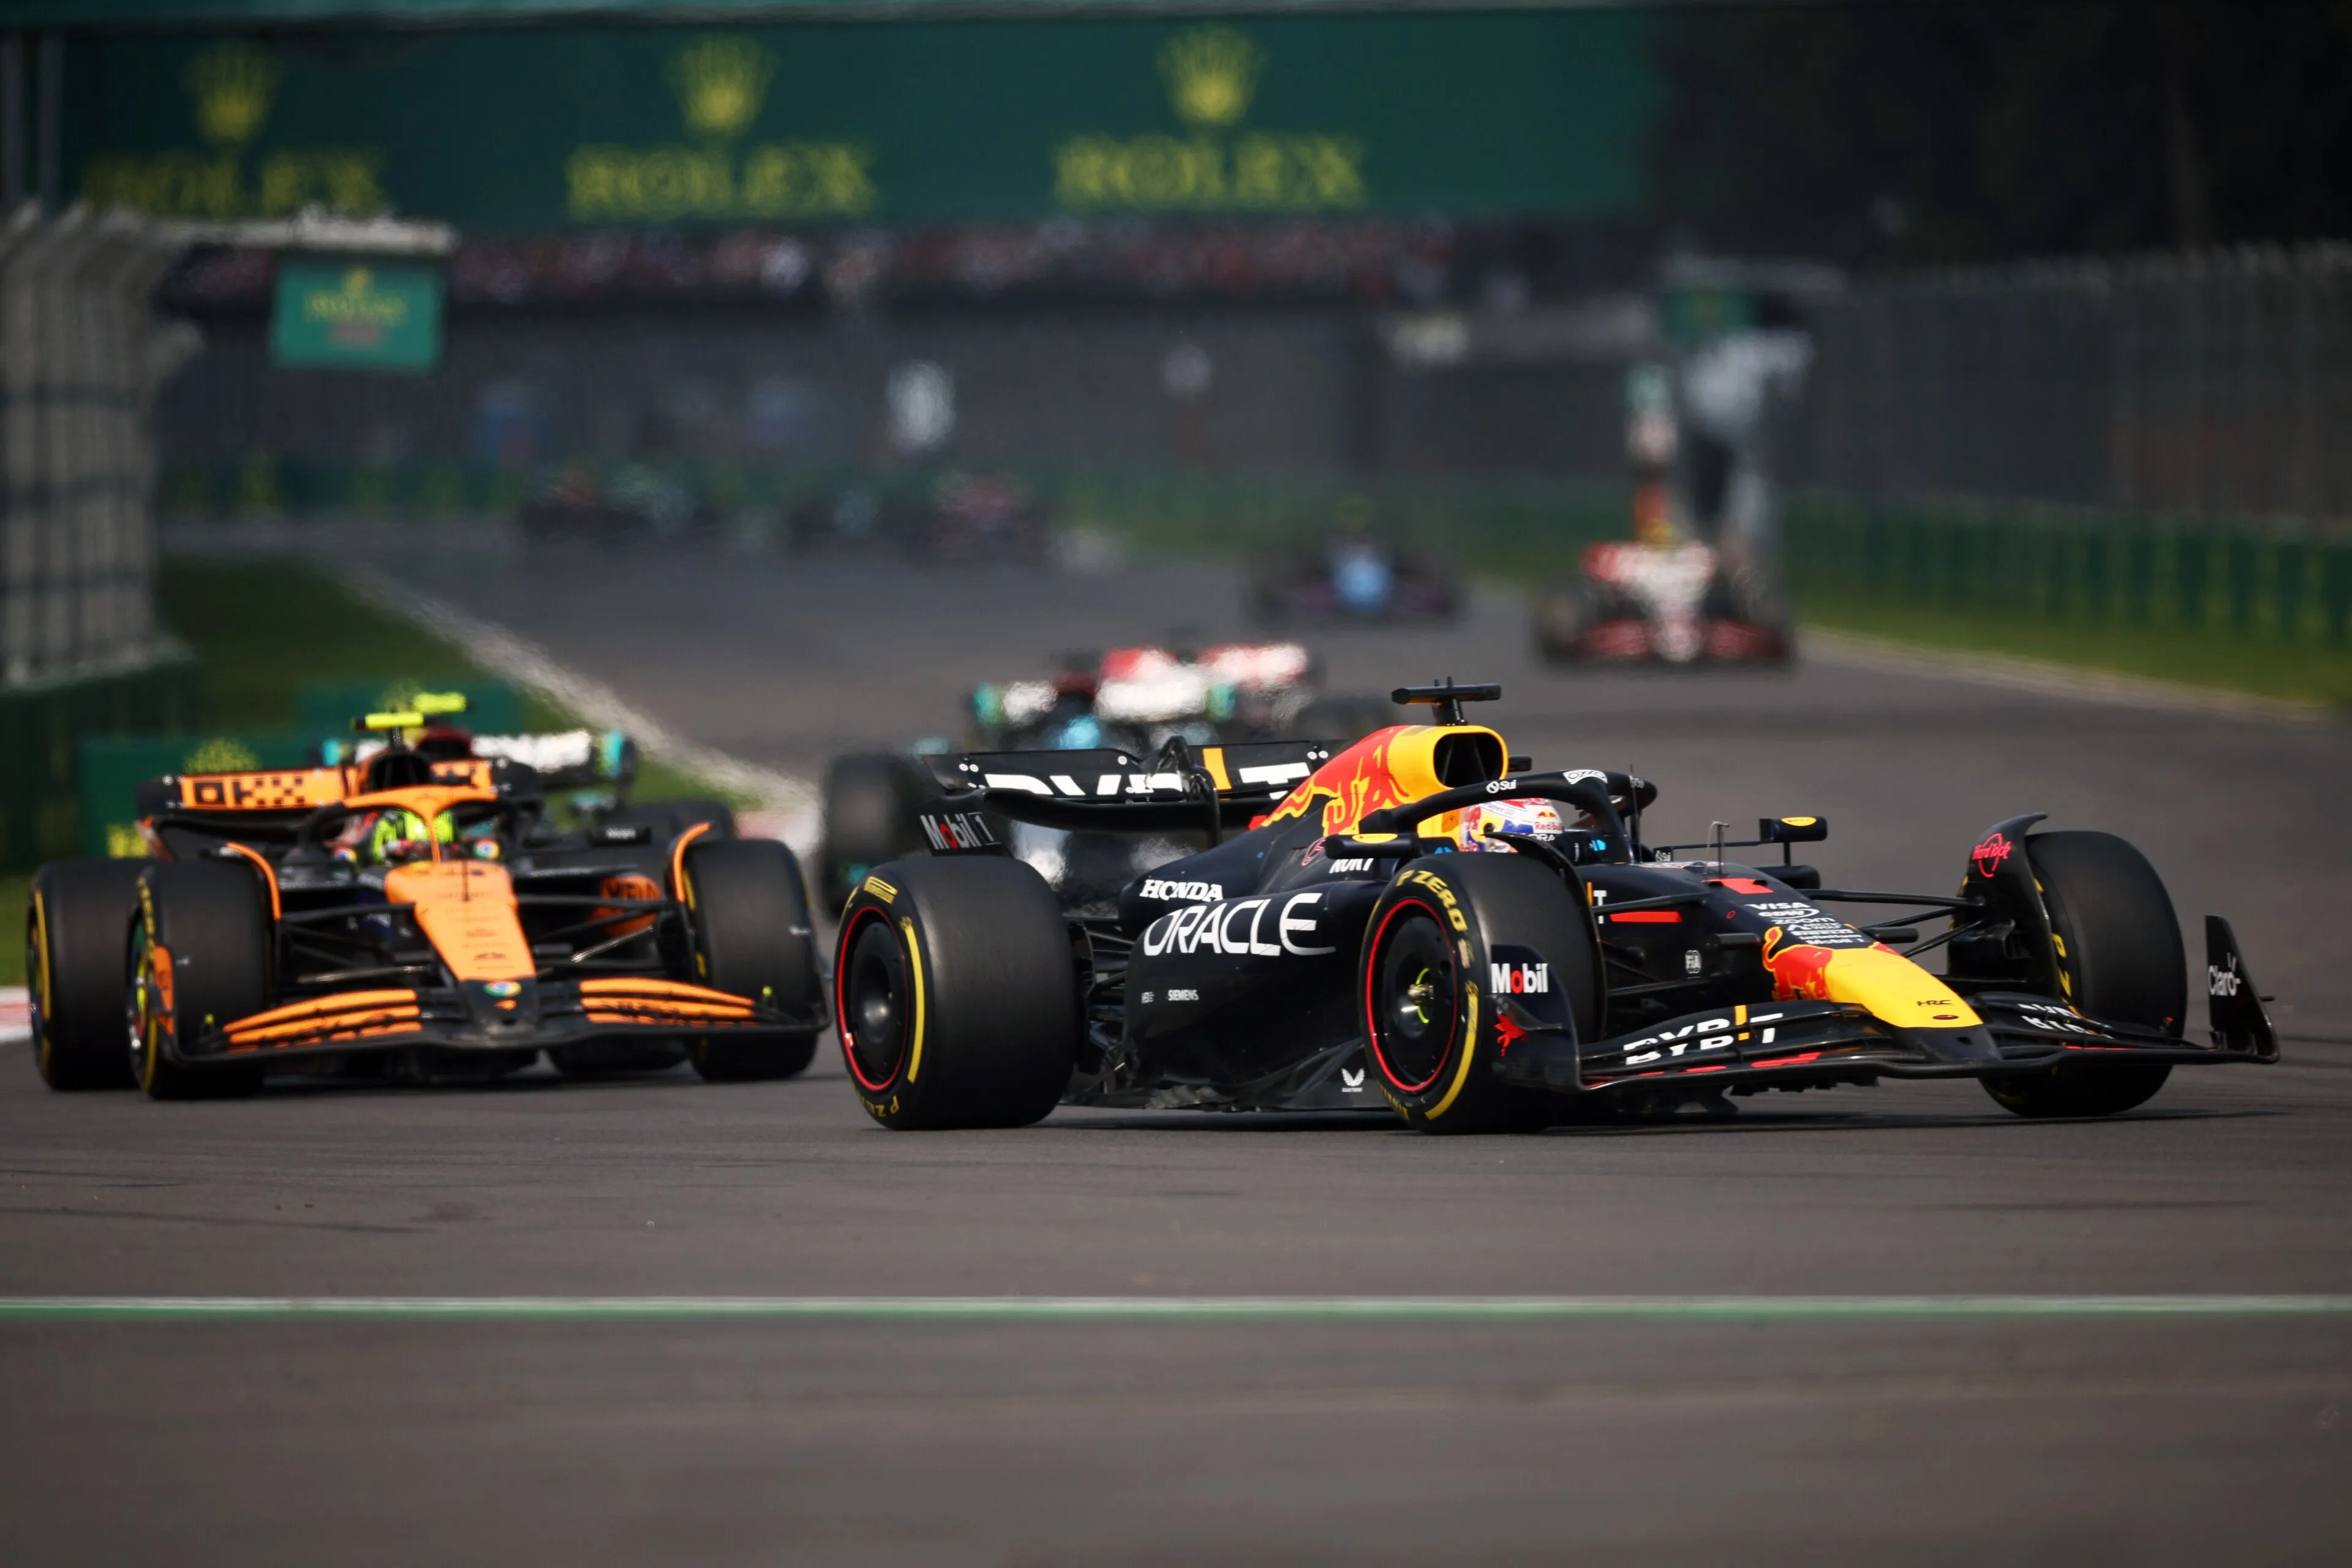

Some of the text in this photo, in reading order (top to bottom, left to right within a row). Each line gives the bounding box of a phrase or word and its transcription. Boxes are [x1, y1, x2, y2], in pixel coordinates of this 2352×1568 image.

[920, 813, 995, 851] Mobil 1
[1139, 880, 1223, 902] HONDA
[1412, 870, 1469, 932] ZERO
[1144, 893, 1336, 956] ORACLE
[1491, 963, 1548, 993] Mobil
